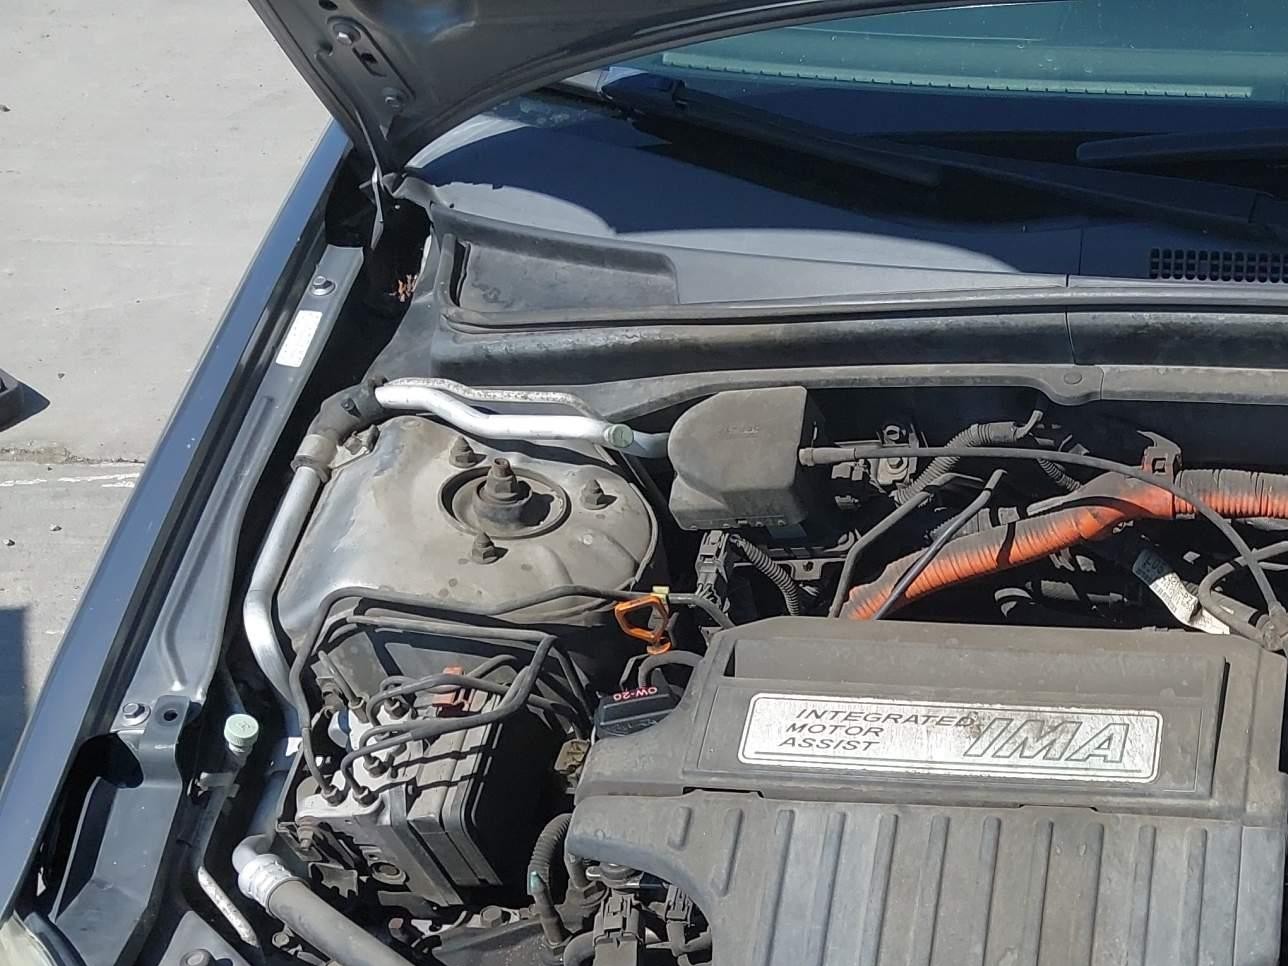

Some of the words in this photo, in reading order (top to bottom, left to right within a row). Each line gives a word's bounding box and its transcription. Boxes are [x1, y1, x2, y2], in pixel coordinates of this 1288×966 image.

[796, 709, 977, 728] INTEGRATED
[785, 723, 884, 738] MOTOR
[778, 737, 881, 752] ASSIST
[964, 718, 1130, 764] IMA
